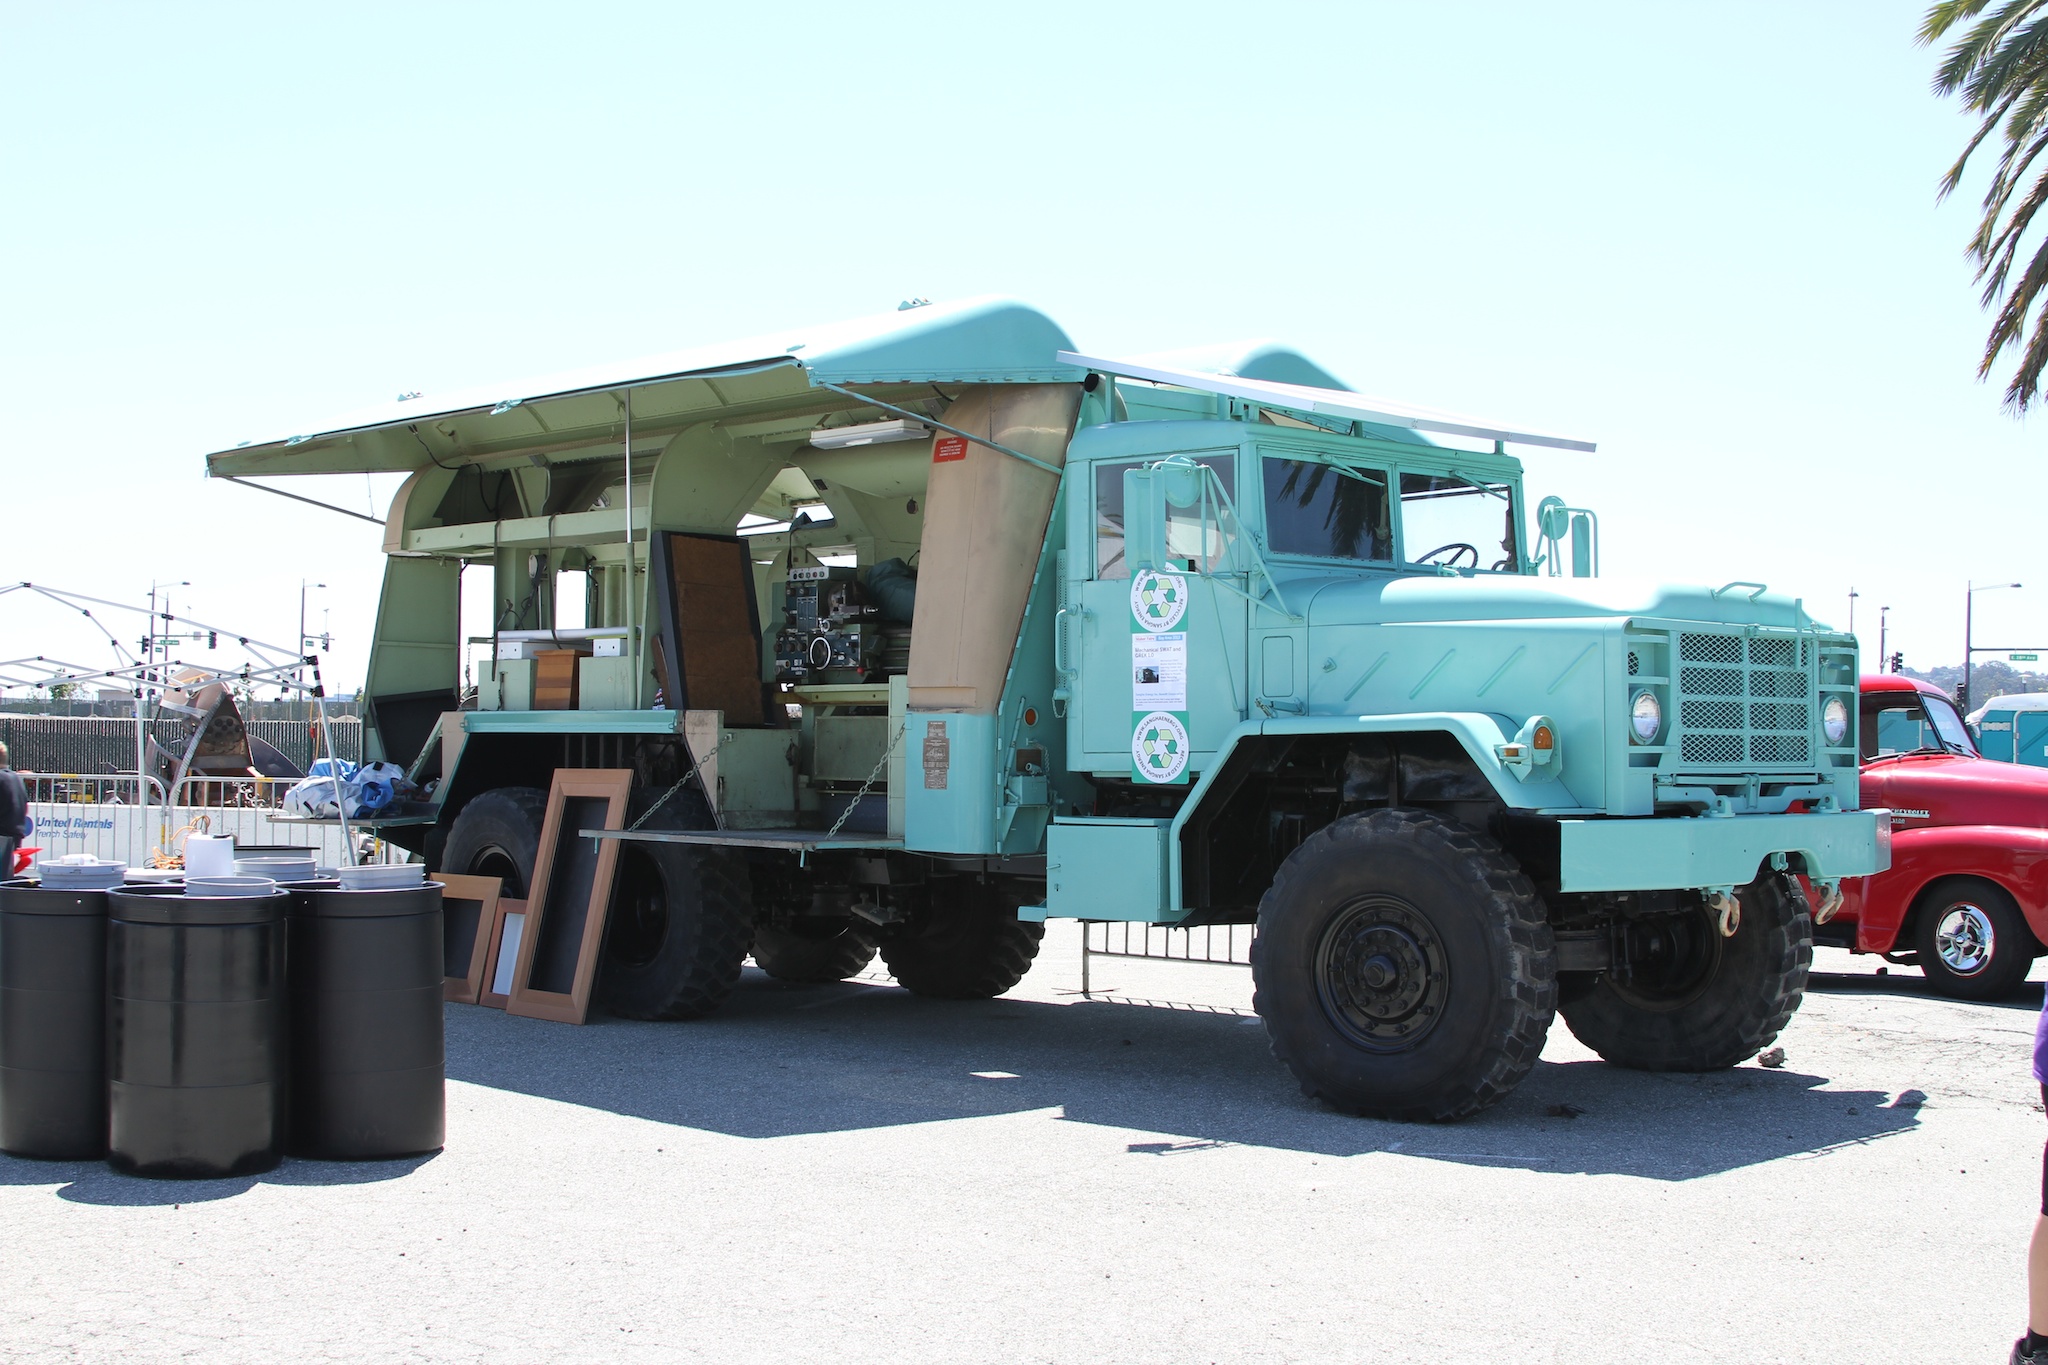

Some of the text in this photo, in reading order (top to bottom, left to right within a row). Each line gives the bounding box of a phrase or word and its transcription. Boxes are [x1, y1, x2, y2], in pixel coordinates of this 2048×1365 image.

[1134, 601, 1145, 621] ENERGY
[1170, 598, 1184, 623] RECYCLED
[1144, 619, 1163, 628] SANGHA
[1136, 750, 1147, 770] ENERGY
[1170, 750, 1185, 774] RECYCLED
[1146, 769, 1164, 779] SANGHA
[73, 817, 113, 829] Rentals
